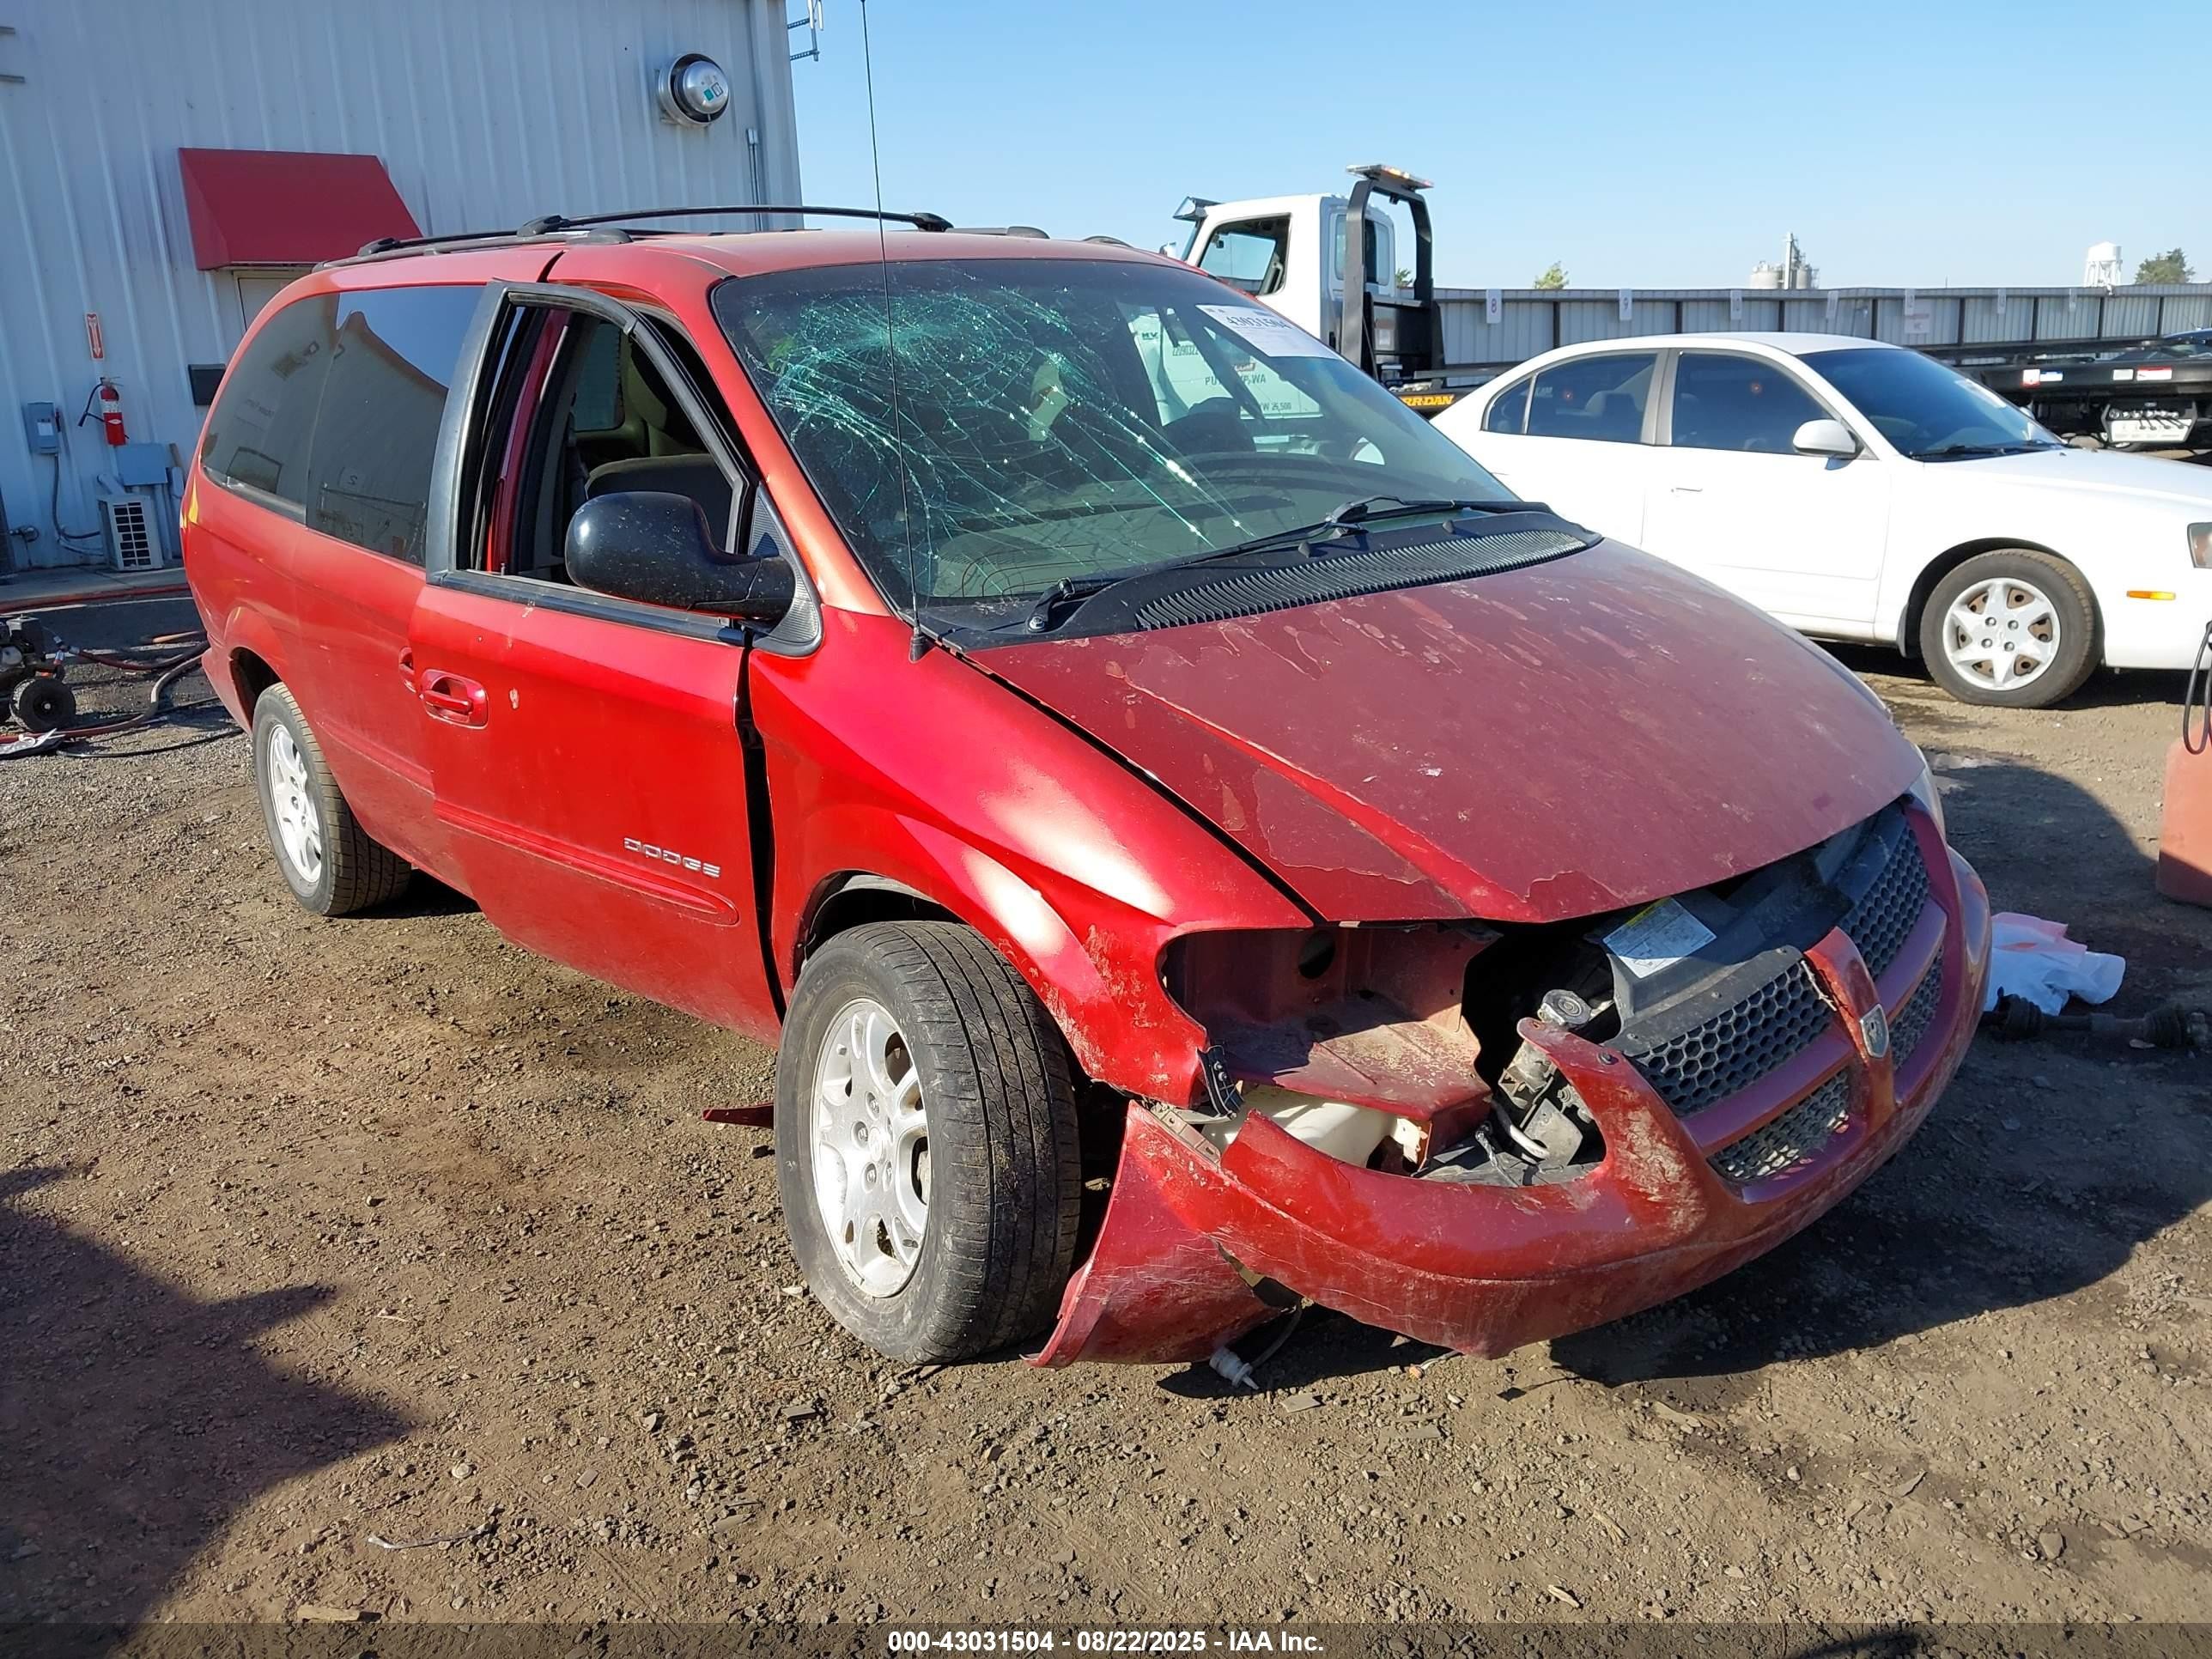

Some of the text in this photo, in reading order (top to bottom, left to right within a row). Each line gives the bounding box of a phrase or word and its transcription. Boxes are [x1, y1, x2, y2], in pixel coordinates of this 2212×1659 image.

[1491, 298, 1498, 313] 8
[1622, 297, 1629, 311] 9
[1226, 315, 1292, 330] 43031504
[1251, 374, 1267, 385] WA
[1401, 394, 1455, 406] RR-DAN
[623, 837, 721, 878] DODGE
